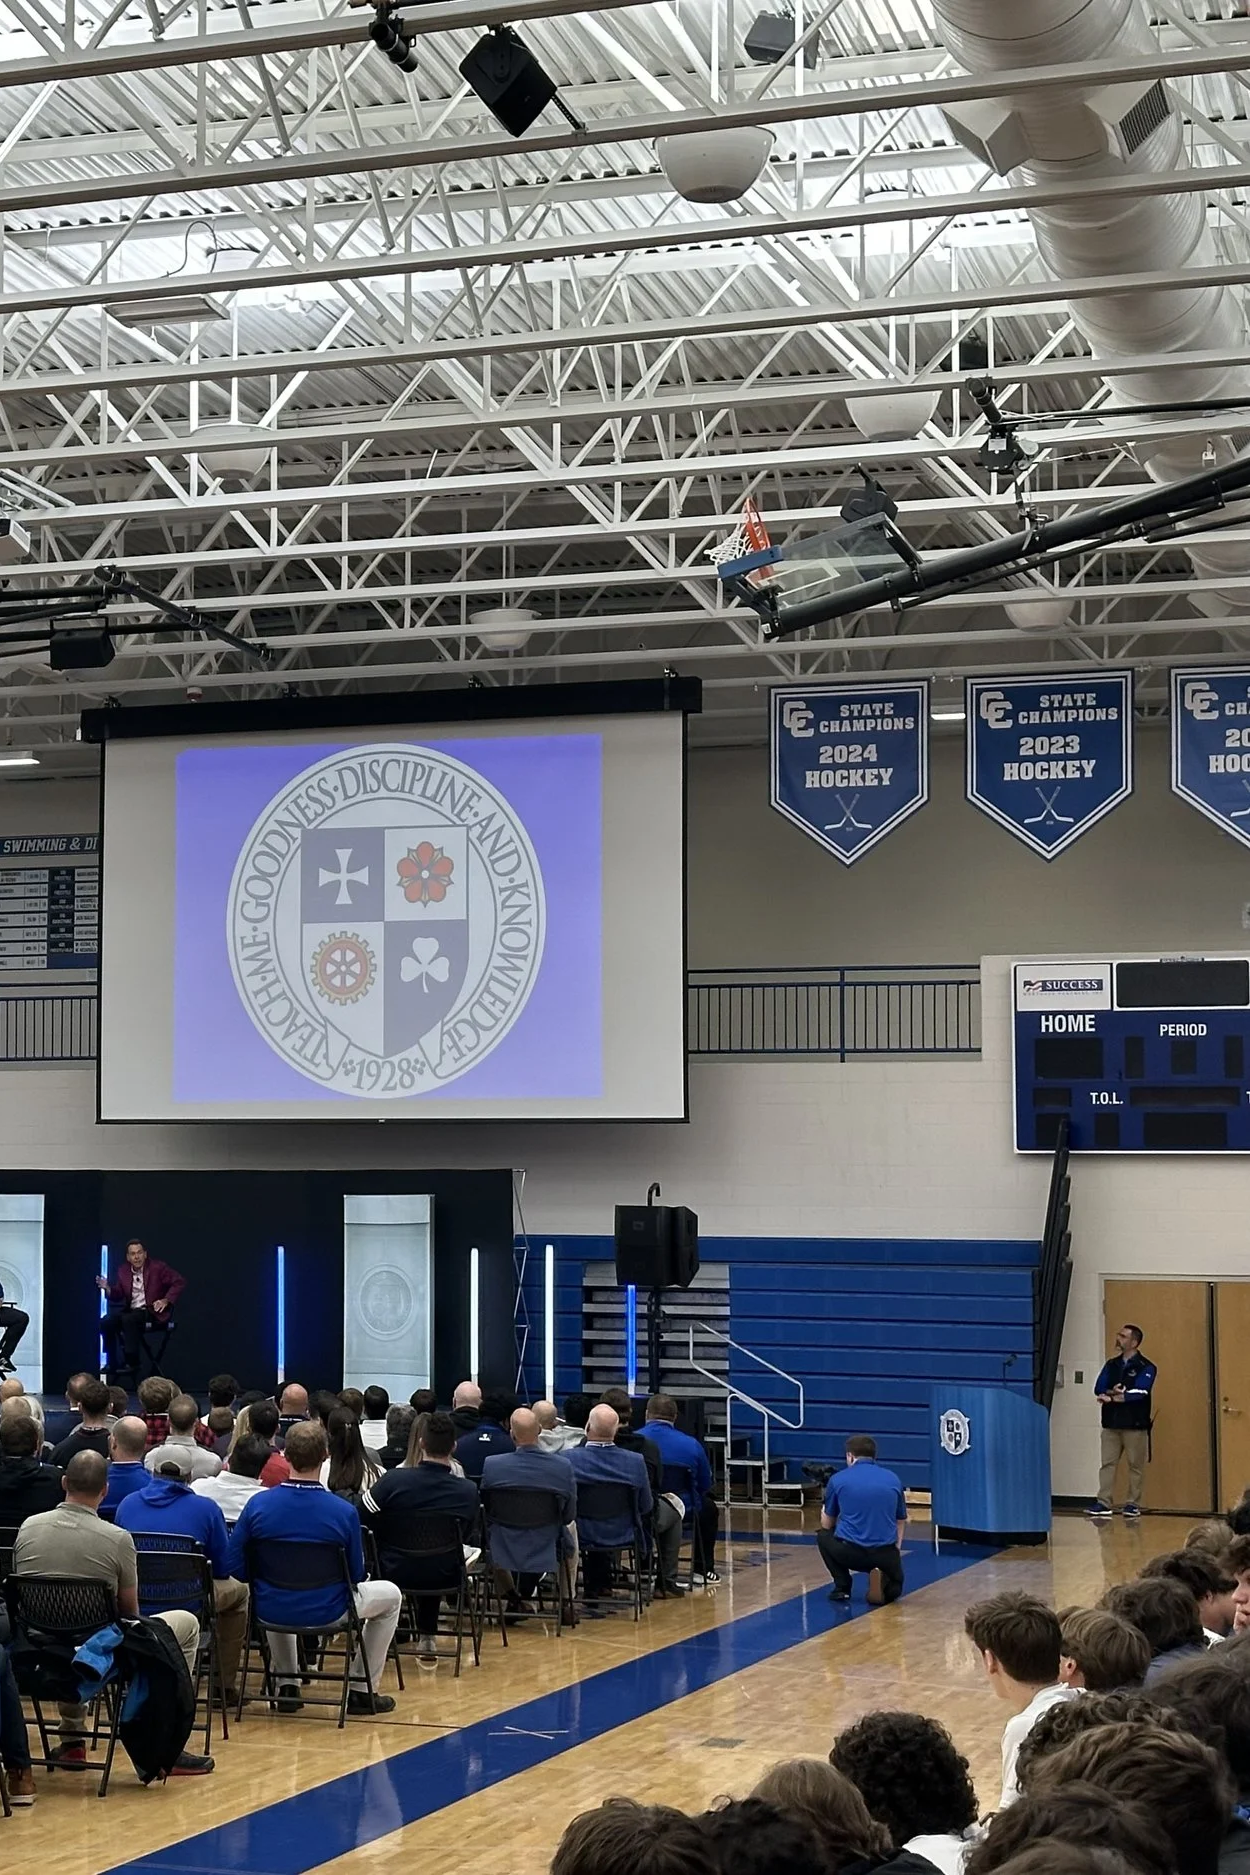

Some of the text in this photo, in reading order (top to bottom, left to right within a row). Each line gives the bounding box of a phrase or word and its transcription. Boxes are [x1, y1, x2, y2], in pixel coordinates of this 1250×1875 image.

[1040, 693, 1096, 708] STATE
[840, 702, 894, 717] STATE
[1018, 708, 1118, 725] CHAMPIONS
[819, 717, 914, 733] CHAMPIONS
[819, 744, 878, 763] 2024
[1019, 736, 1080, 755] 2023
[805, 768, 893, 788] HOCKEY
[1003, 760, 1096, 781] HOCKEY
[3, 838, 66, 853] SWIMMING
[70, 837, 81, 851] &
[240, 758, 532, 1069] TEACH ME GOODNESS DISCIPLINE AND KNOWLEDGE
[1046, 980, 1098, 989] SUCCESS
[1041, 1015, 1096, 1032] HOME
[1160, 1024, 1207, 1036] PERIOD
[352, 1057, 416, 1092] 1928
[1090, 1092, 1123, 1104] T.O.L.
